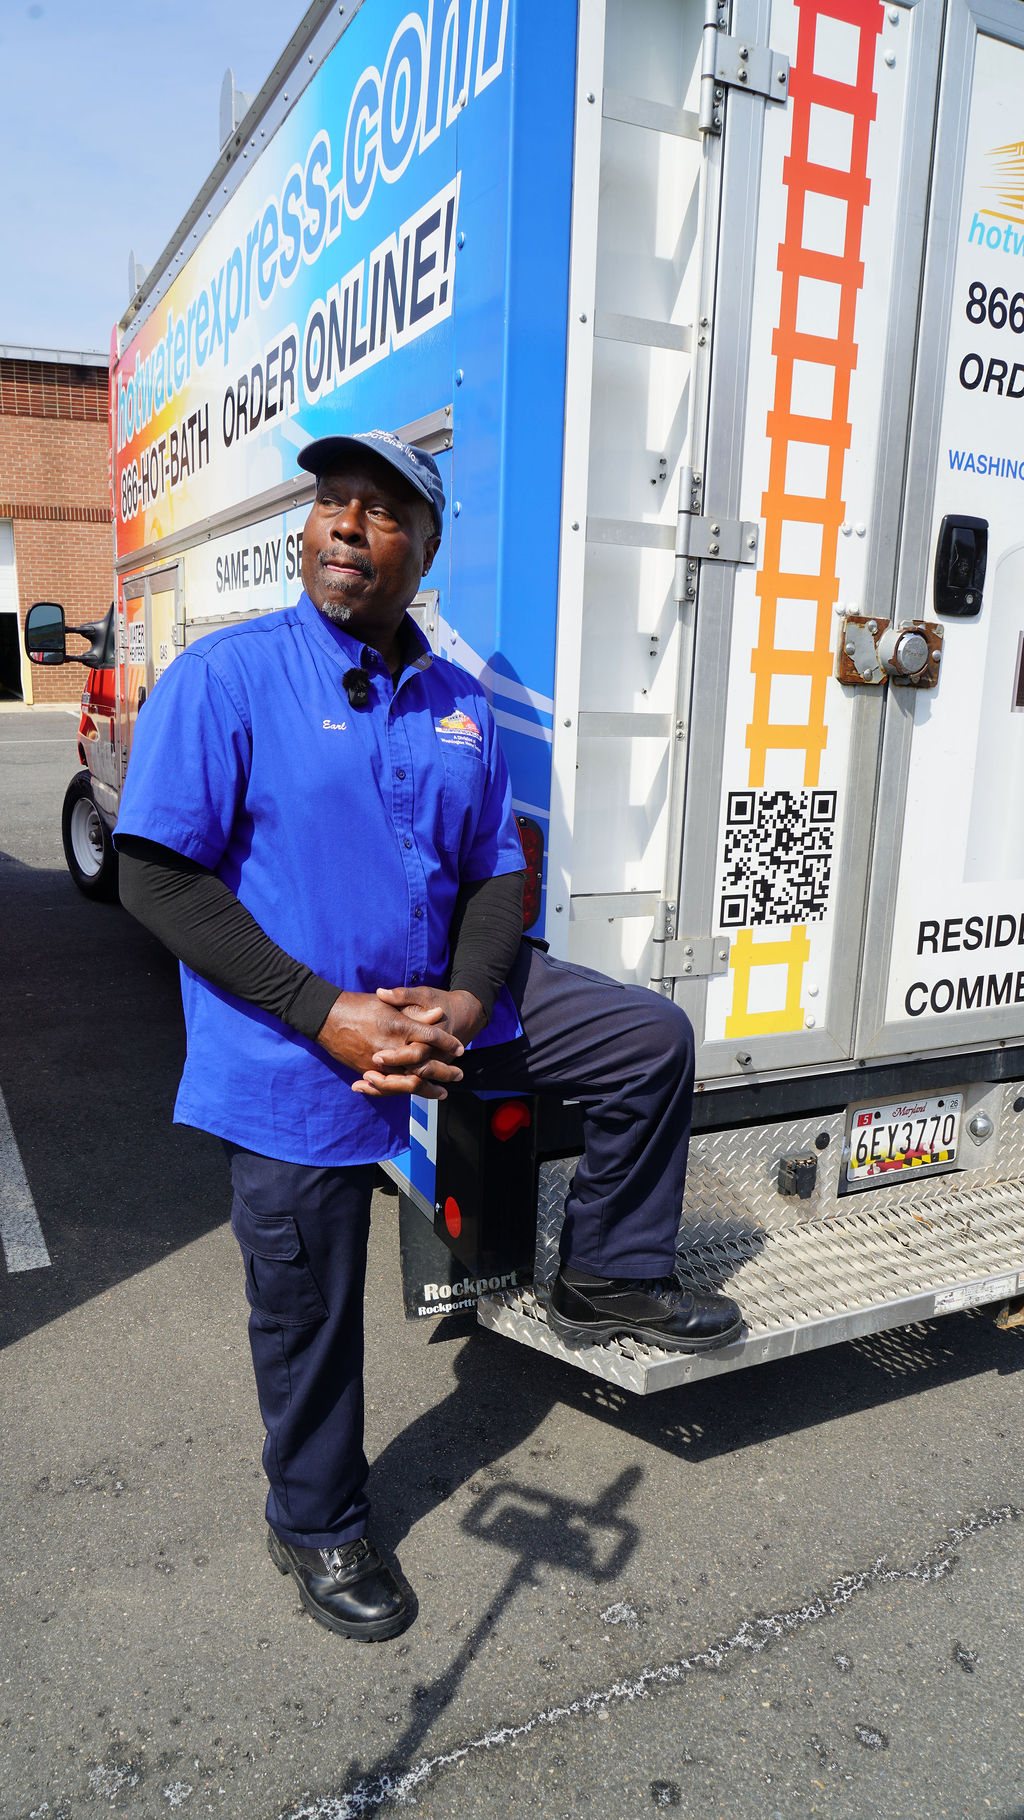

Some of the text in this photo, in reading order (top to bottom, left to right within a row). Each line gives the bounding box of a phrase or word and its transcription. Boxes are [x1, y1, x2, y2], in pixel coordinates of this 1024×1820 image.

[121, 195, 455, 520] 866-HOT-BATH ORDER ONLINE!
[216, 548, 250, 593] SAME
[253, 538, 281, 585] DAY
[322, 719, 347, 731] Earl
[863, 1115, 869, 1124] 5
[892, 1102, 928, 1119] Maryland
[855, 1114, 956, 1164] 6EY3770
[423, 1271, 518, 1302] Rockport
